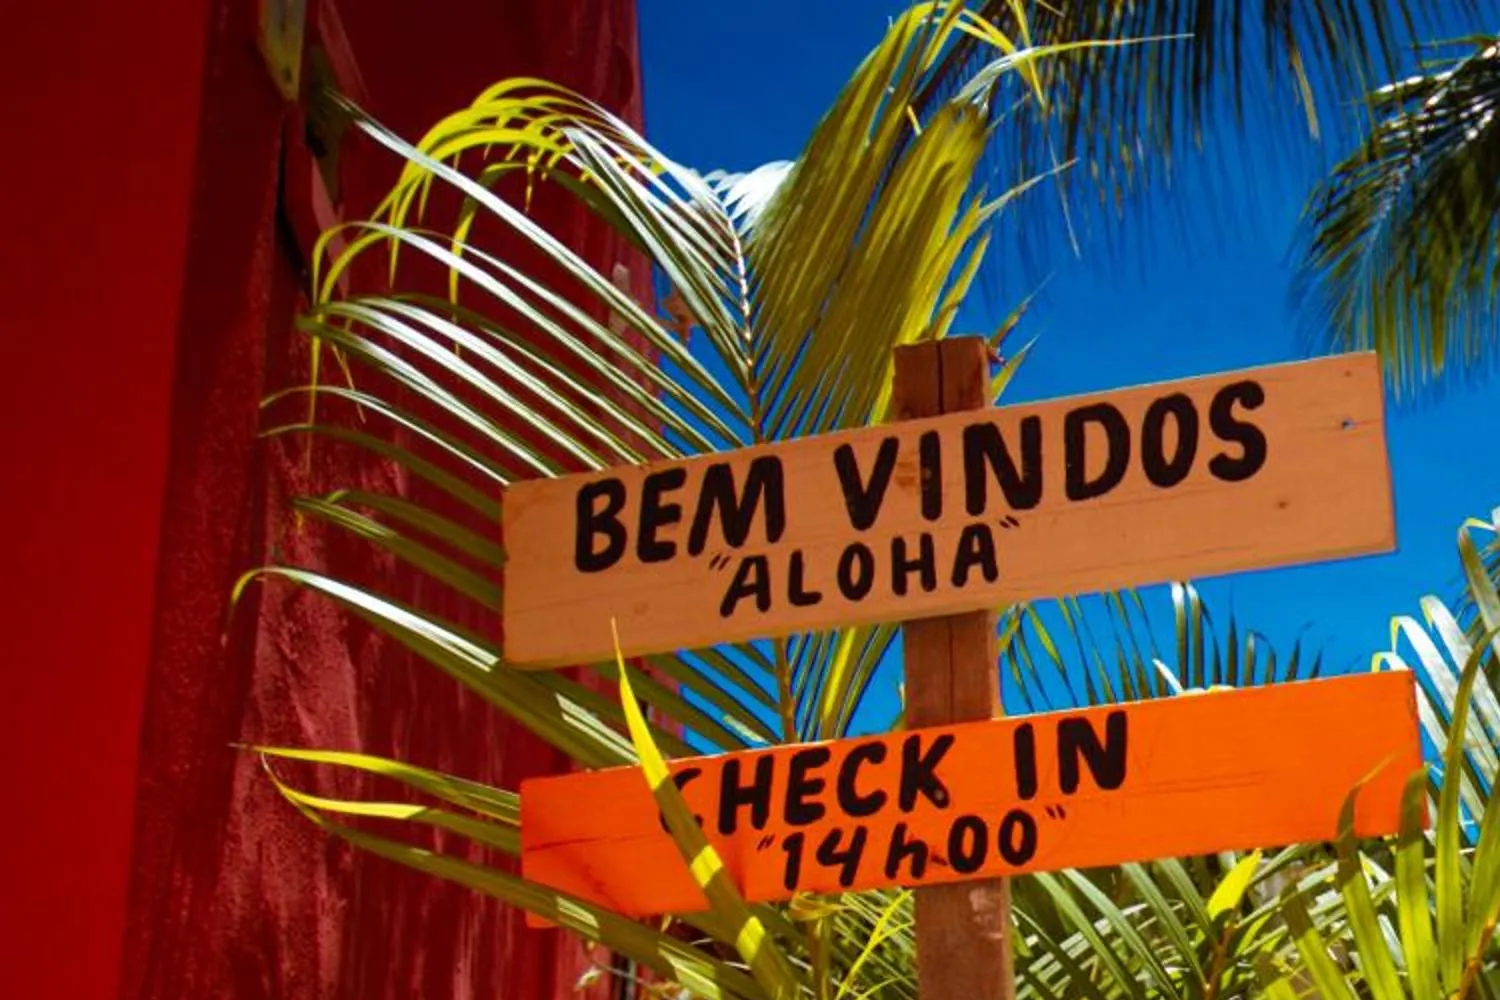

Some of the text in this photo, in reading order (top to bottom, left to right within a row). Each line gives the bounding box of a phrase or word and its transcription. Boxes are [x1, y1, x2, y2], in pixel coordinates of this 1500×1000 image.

[574, 380, 1268, 572] BEM VINDOS
[1014, 710, 1130, 796] IN
